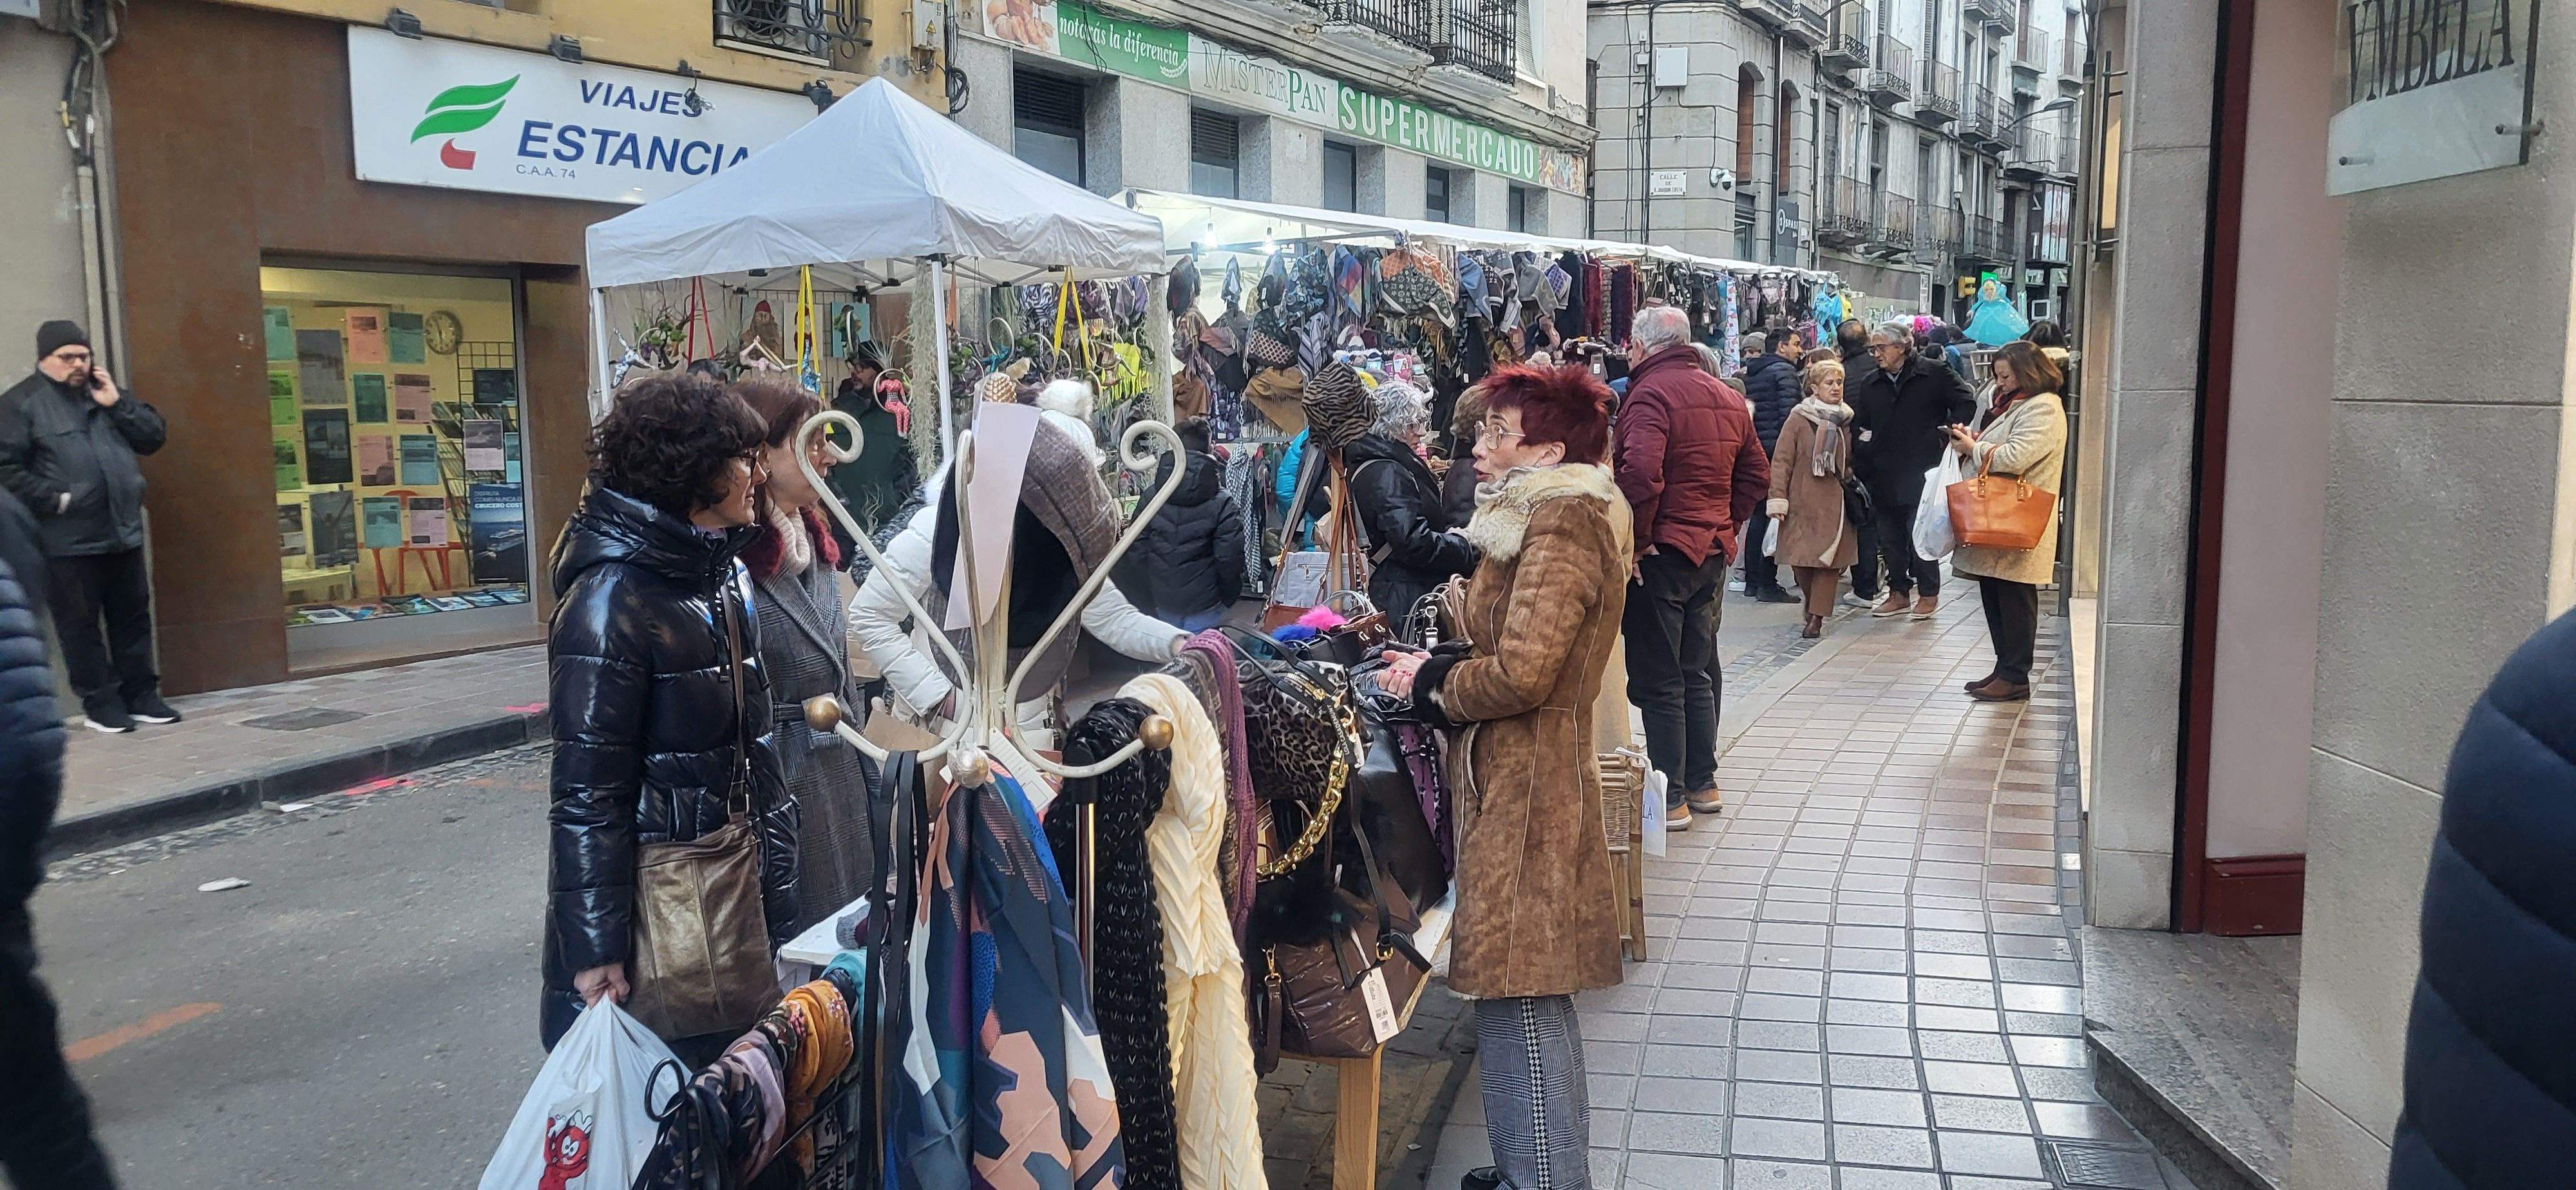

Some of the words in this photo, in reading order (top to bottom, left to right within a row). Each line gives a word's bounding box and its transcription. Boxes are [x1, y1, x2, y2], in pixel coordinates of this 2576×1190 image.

[1110, 24, 1121, 50] la
[1124, 29, 1179, 66] diferencia
[1340, 87, 1535, 179] SUPERMERCADO
[516, 164, 557, 177] C.A.A.
[561, 168, 576, 180] 74
